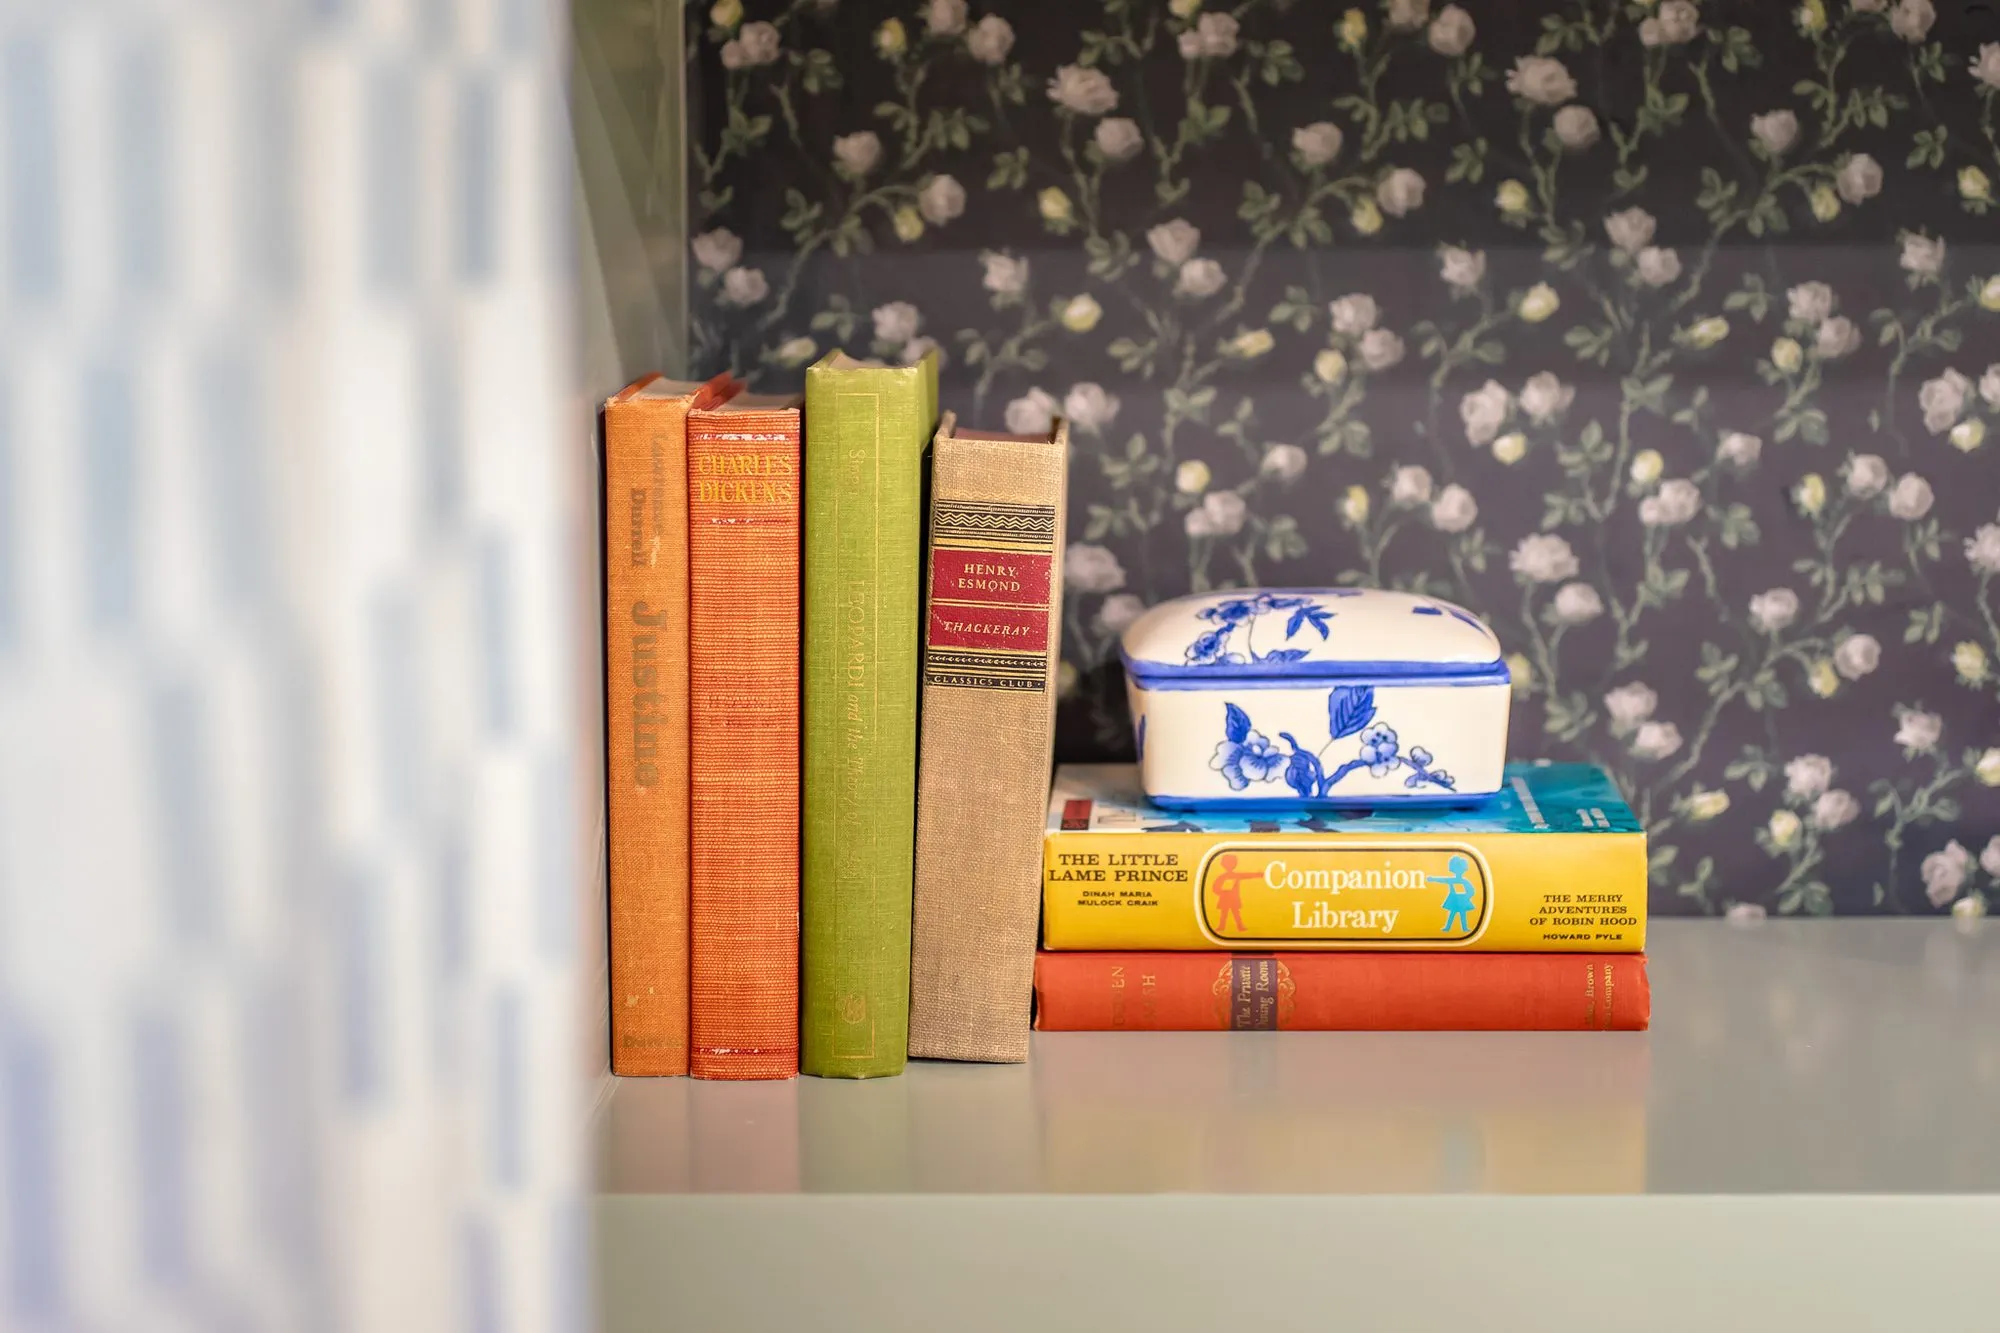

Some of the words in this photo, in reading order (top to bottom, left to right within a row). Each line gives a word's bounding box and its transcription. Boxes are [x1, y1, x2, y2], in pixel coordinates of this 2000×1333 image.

[699, 454, 792, 475] CHARLES
[700, 480, 793, 504] DICKENS
[631, 488, 646, 566] Durrell
[964, 564, 1016, 577] HENRY
[958, 578, 1020, 592] ESMOND
[848, 581, 864, 687] LEOPARDI
[943, 621, 1030, 636] THACKERAY
[934, 676, 993, 686] CLASSICS
[1000, 679, 1034, 688] CLUB
[631, 601, 668, 787] Justine
[847, 694, 863, 722] and
[847, 728, 863, 750] the
[1058, 854, 1100, 866] THE
[1108, 854, 1179, 866] LITTLE
[1049, 870, 1106, 882] LAME
[1114, 870, 1188, 882] PRINCE
[1264, 860, 1427, 895] Companion
[1543, 894, 1571, 903] THE
[1576, 894, 1623, 903] MERRY
[1292, 901, 1399, 933] Library
[1538, 906, 1627, 915] ADVENTURES
[1529, 917, 1548, 926] OF
[1553, 917, 1594, 926] ROBIN
[1600, 917, 1637, 926] HOOD
[1255, 960, 1269, 993] Room
[1584, 964, 1594, 997] Brown
[1603, 963, 1614, 1009] Company
[1236, 1007, 1251, 1028] The
